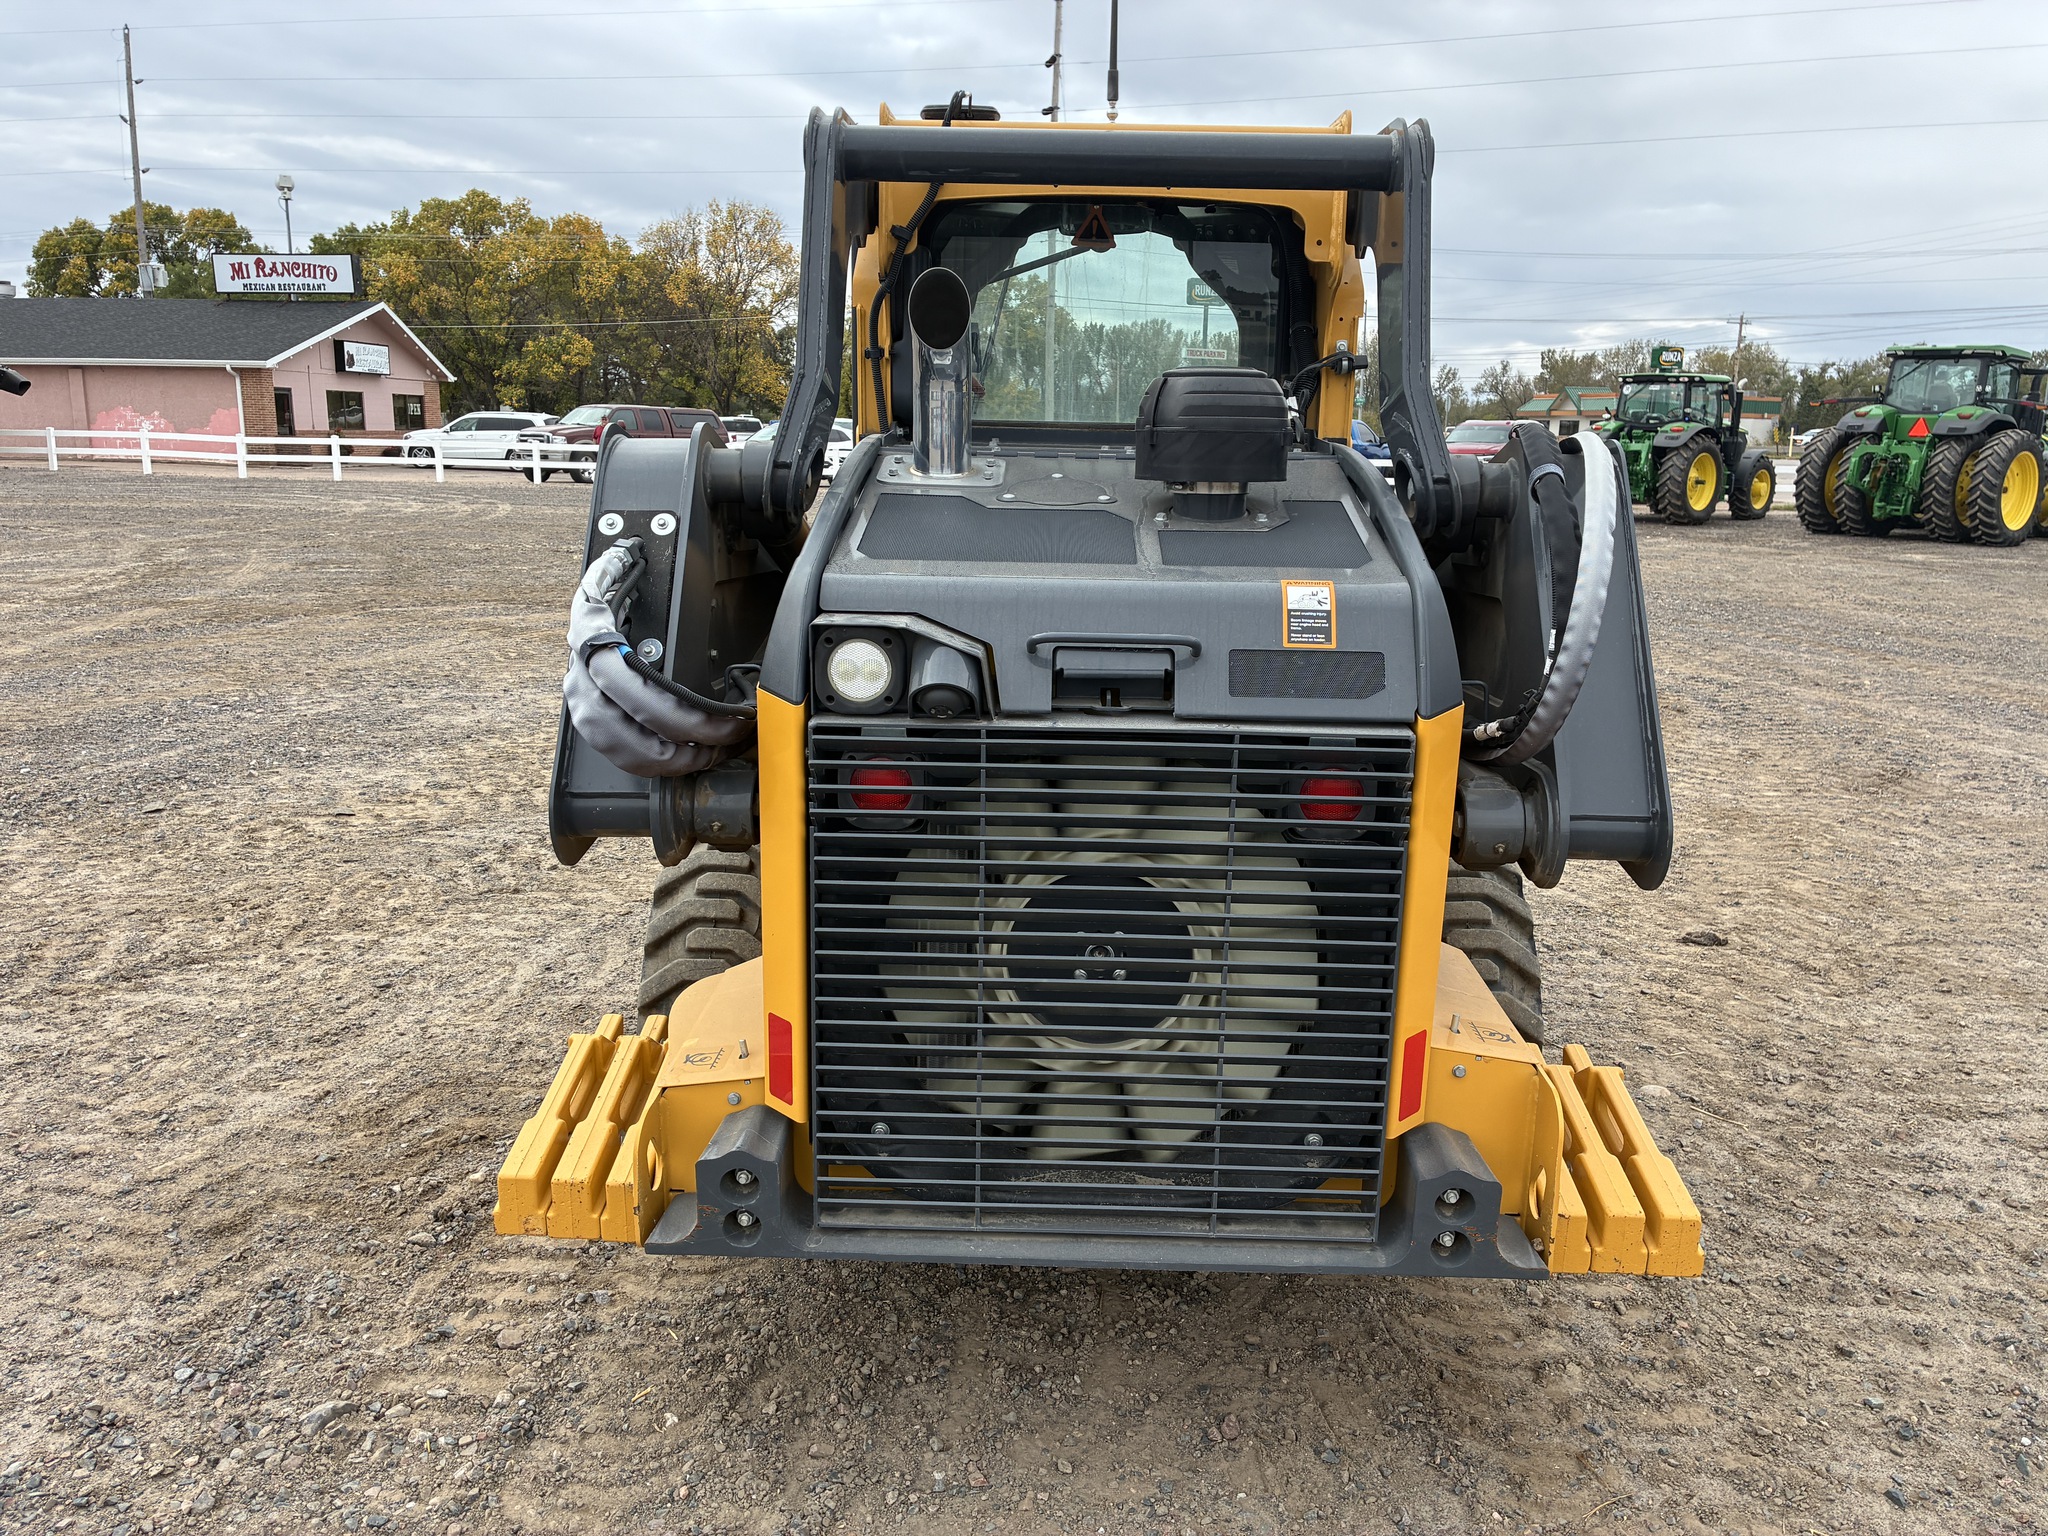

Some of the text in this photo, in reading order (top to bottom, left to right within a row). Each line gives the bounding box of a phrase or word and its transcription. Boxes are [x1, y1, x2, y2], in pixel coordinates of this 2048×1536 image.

[229, 257, 338, 282] MI RANCHITO
[242, 283, 327, 291] MEXICAN RESTAURANT
[1204, 350, 1225, 358] PARKING
[1662, 352, 1681, 362] RUNZA
